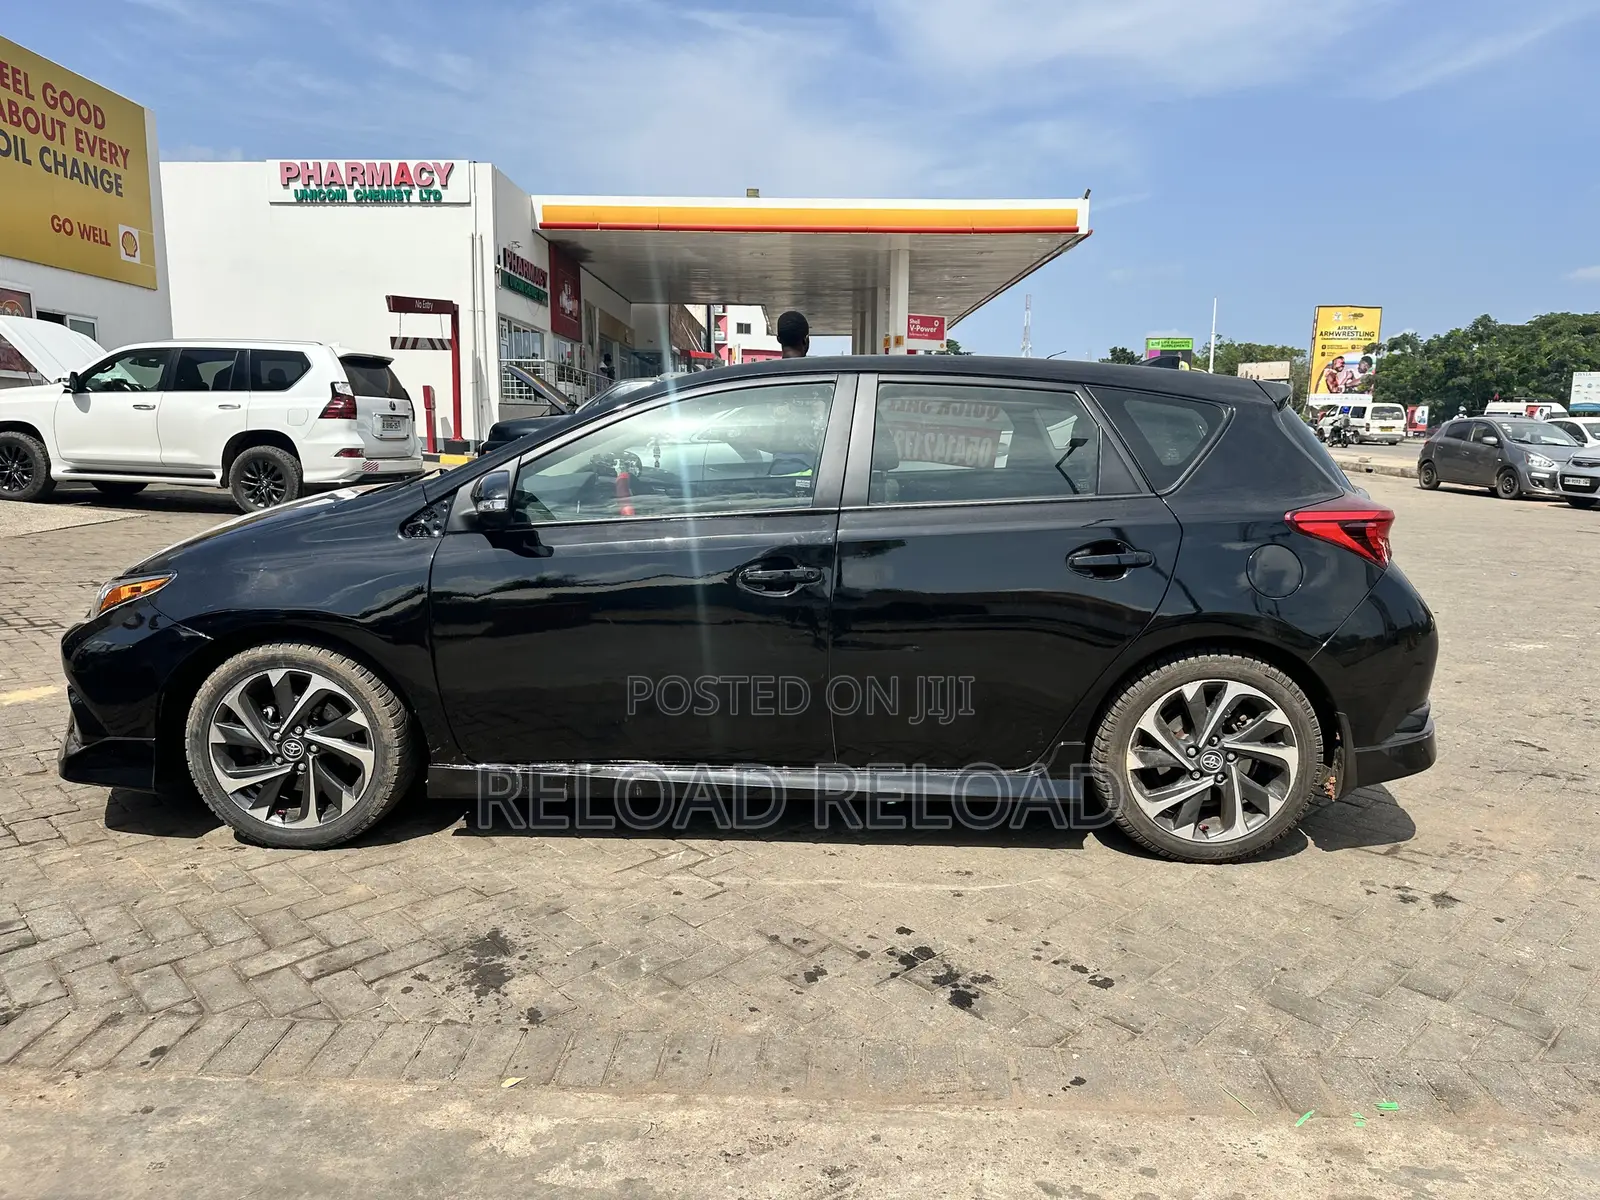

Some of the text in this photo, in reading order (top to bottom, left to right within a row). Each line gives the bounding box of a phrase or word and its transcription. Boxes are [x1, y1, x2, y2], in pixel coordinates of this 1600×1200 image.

[42, 82, 106, 131] GOOD
[0, 128, 124, 198] OIL CHANGE
[74, 127, 131, 171] EVERY
[279, 161, 455, 188] PHARMACY
[293, 188, 443, 203] UNICOM CHEMIST LTD
[50, 214, 112, 248] GO WELL
[503, 247, 548, 289] PHARMACY
[414, 299, 434, 312] No Entry
[909, 324, 937, 333] V-Power
[1318, 330, 1375, 338] ARMWRESTLING
